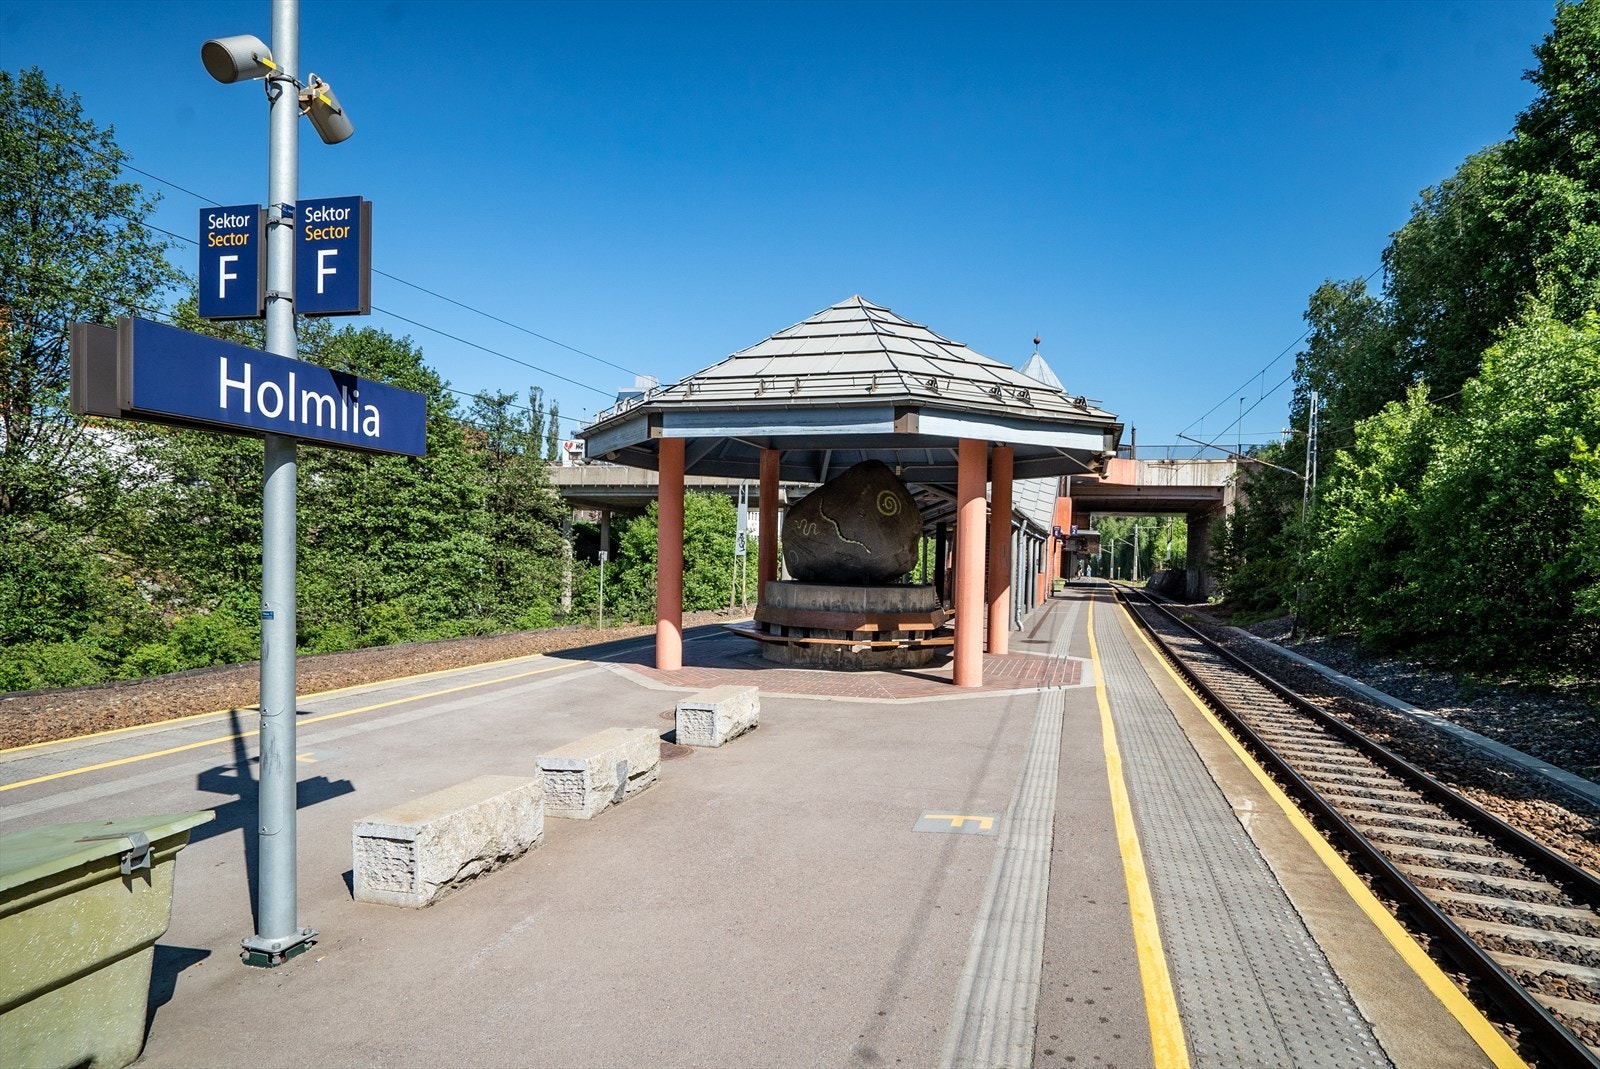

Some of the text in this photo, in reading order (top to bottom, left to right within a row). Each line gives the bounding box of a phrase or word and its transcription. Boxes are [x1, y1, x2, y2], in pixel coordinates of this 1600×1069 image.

[208, 213, 250, 230] Sektor
[305, 206, 350, 223] Sektor
[208, 232, 250, 247] Sector
[305, 225, 350, 241] Sector
[219, 255, 239, 299] F
[317, 249, 338, 294] F
[219, 356, 380, 438] Holmlia
